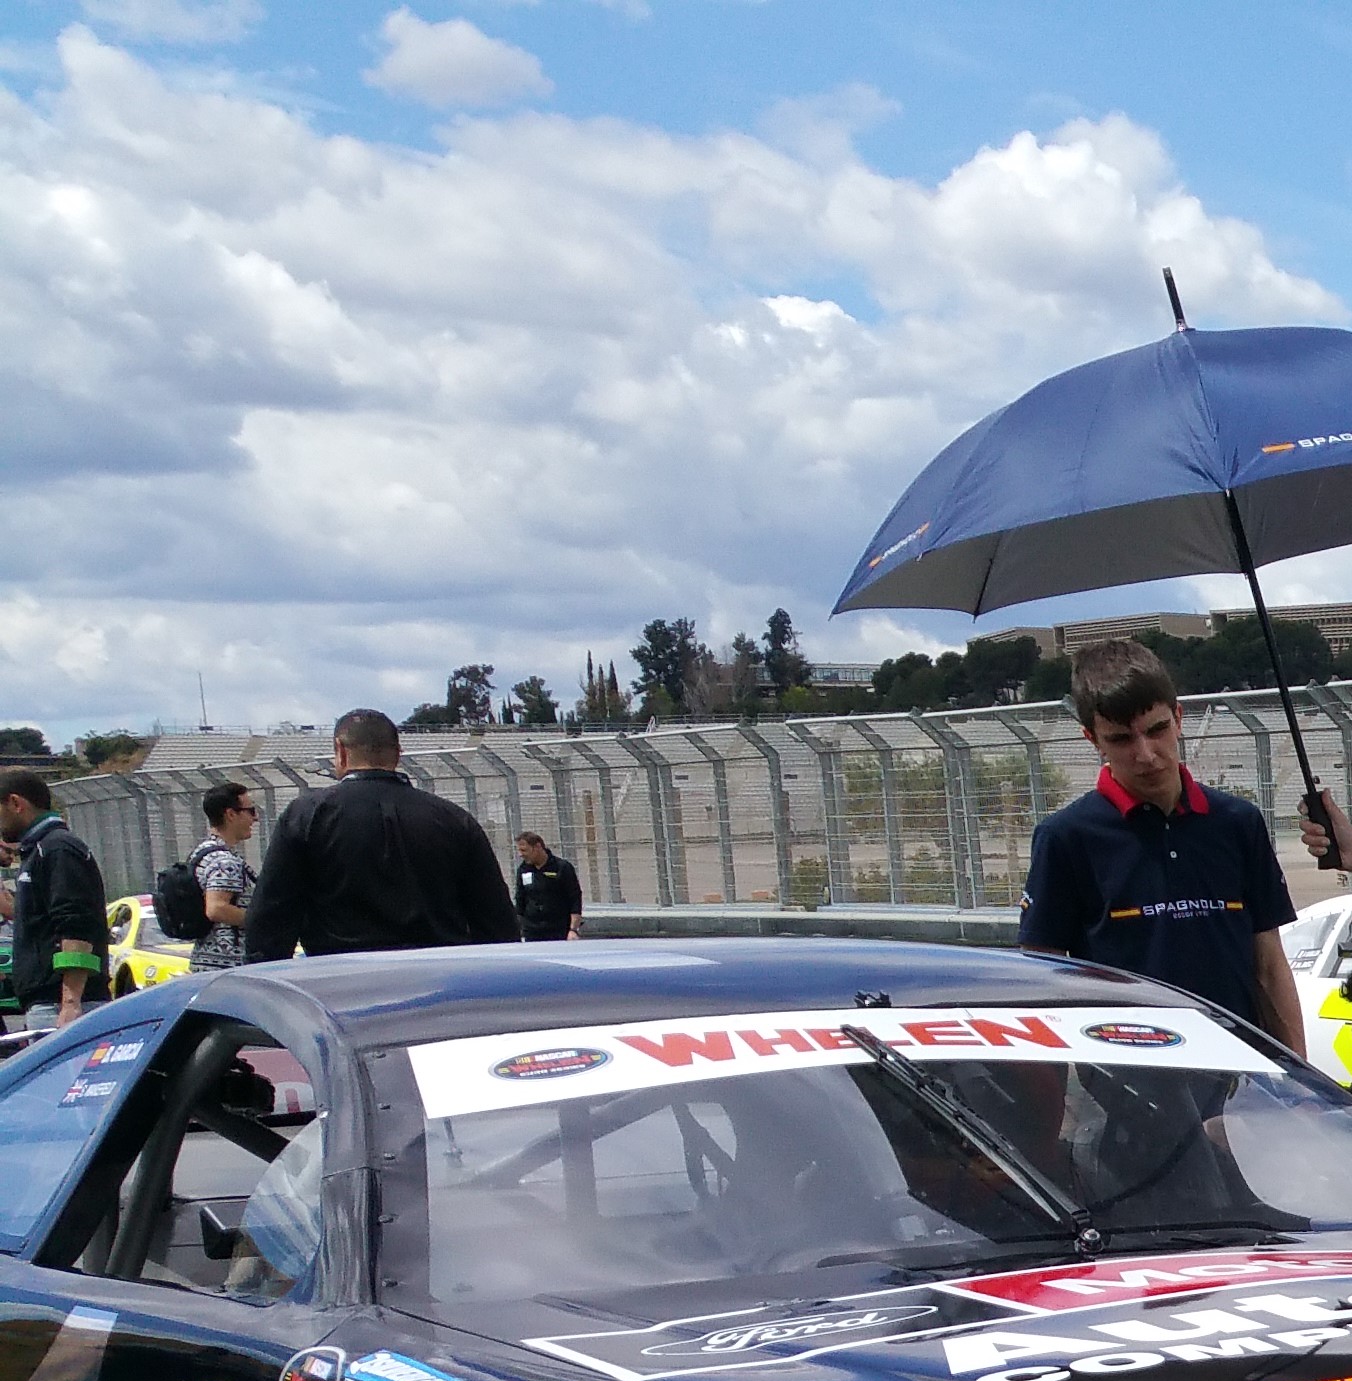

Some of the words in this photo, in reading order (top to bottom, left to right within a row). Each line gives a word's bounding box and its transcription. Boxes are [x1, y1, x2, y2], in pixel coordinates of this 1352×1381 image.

[1142, 898, 1225, 916] SPAGNOLO
[613, 1016, 1071, 1068] WHELEN
[701, 1311, 888, 1351] Ford
